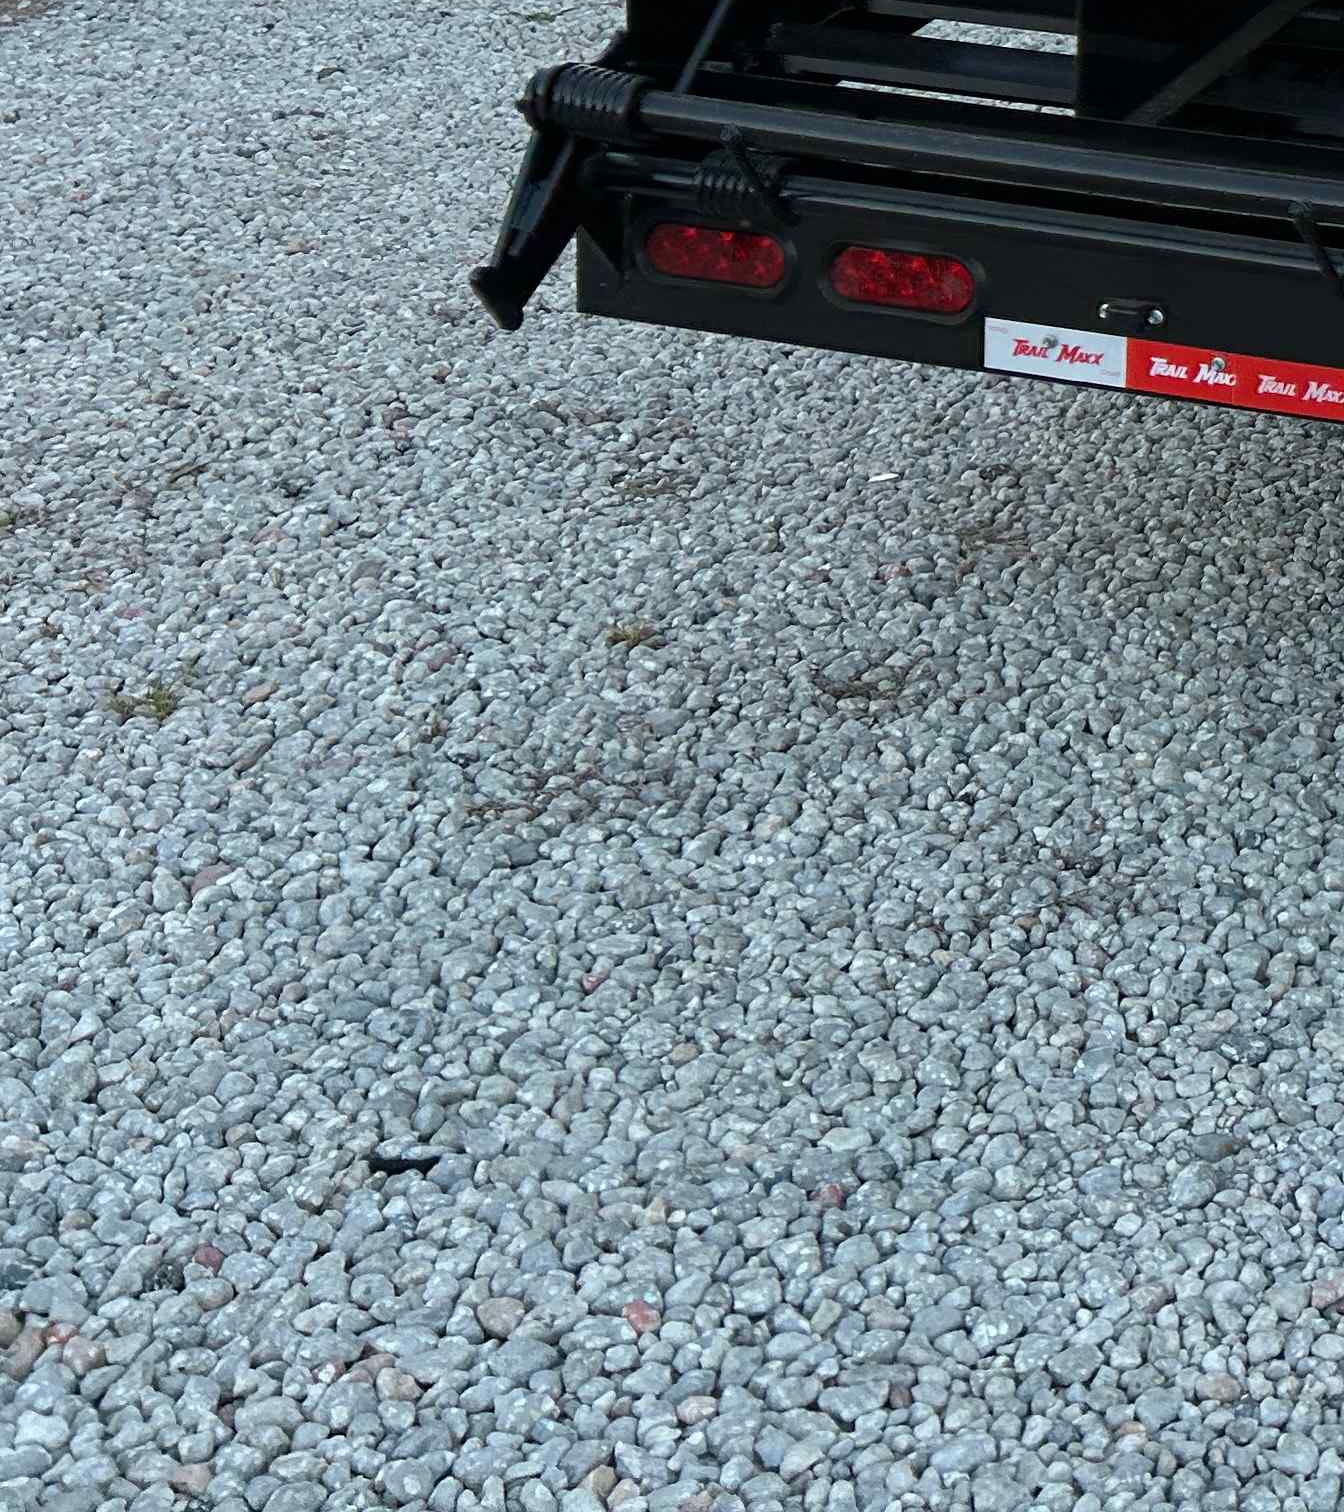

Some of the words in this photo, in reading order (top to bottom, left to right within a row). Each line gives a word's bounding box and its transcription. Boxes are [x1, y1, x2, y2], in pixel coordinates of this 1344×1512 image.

[1012, 338, 1049, 358] TRAIL
[1055, 343, 1105, 366] MAXX
[1149, 356, 1188, 379] TRAIL
[1256, 374, 1298, 397] TRAIL
